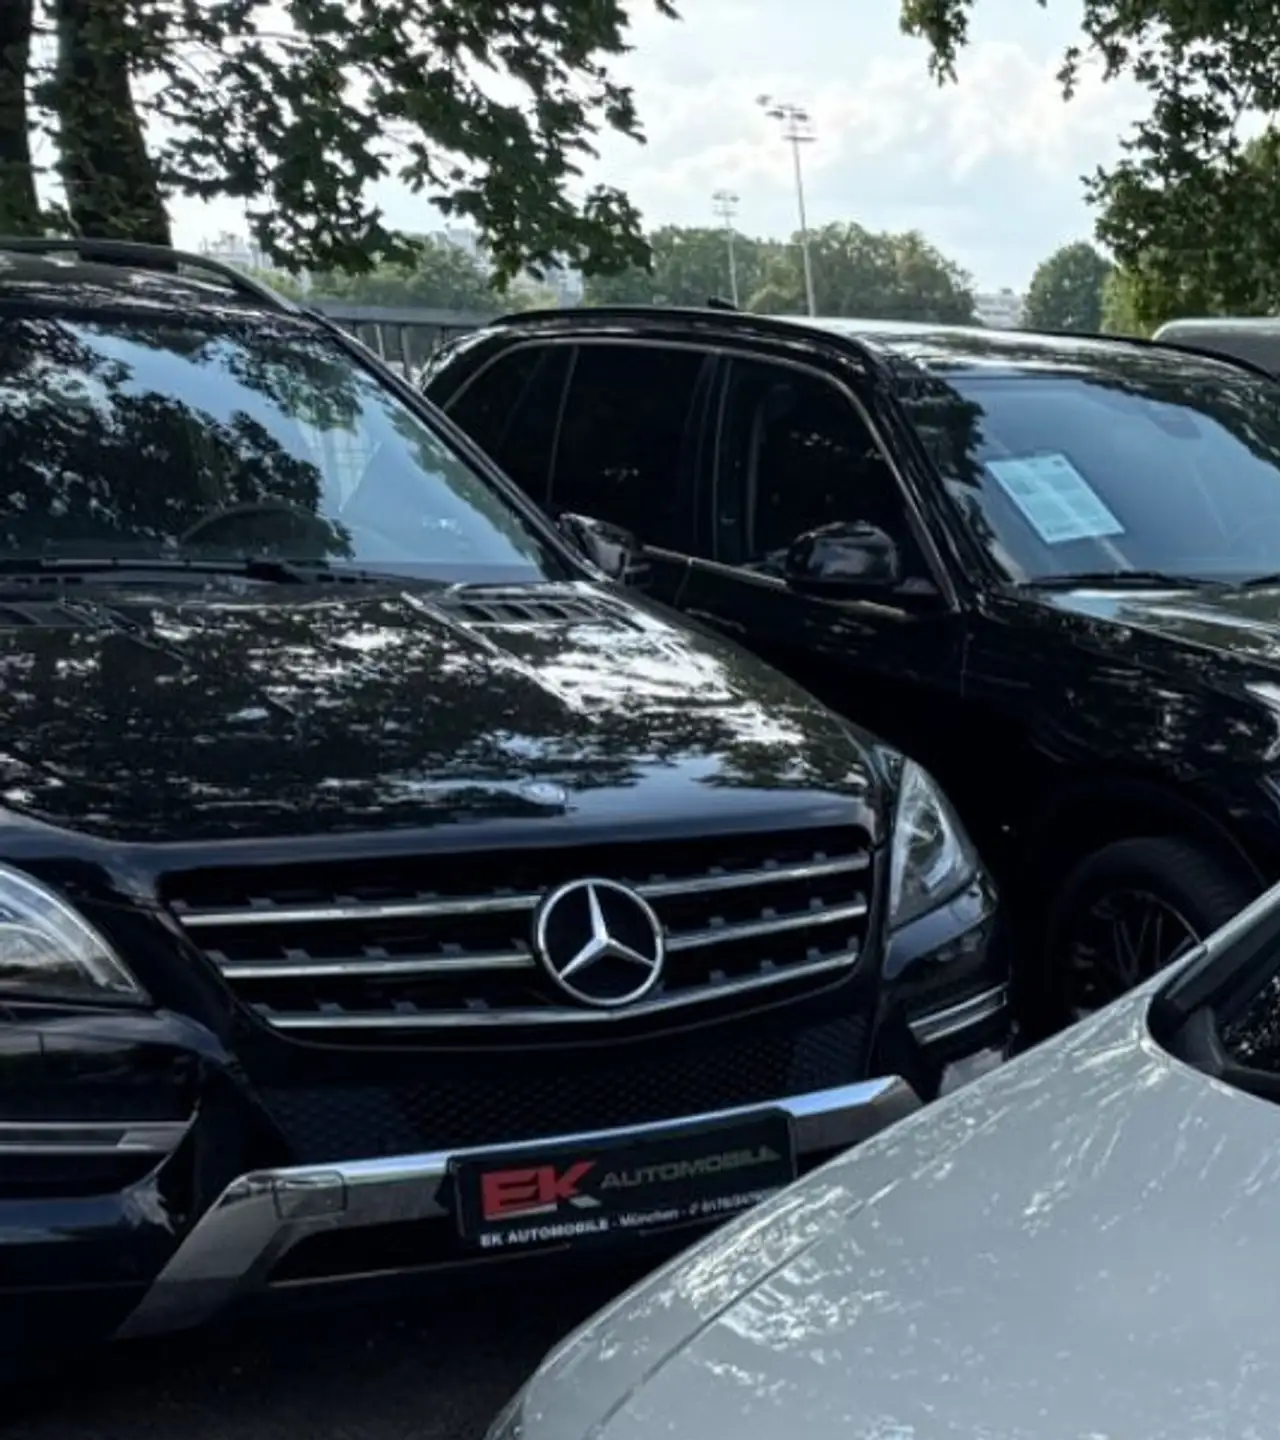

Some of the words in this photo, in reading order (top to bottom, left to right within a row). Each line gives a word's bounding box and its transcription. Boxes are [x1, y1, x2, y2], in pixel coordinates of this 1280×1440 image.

[481, 1160, 597, 1220] EK
[479, 1231, 503, 1248] EK
[507, 1217, 610, 1247] AUTOMOBILE
